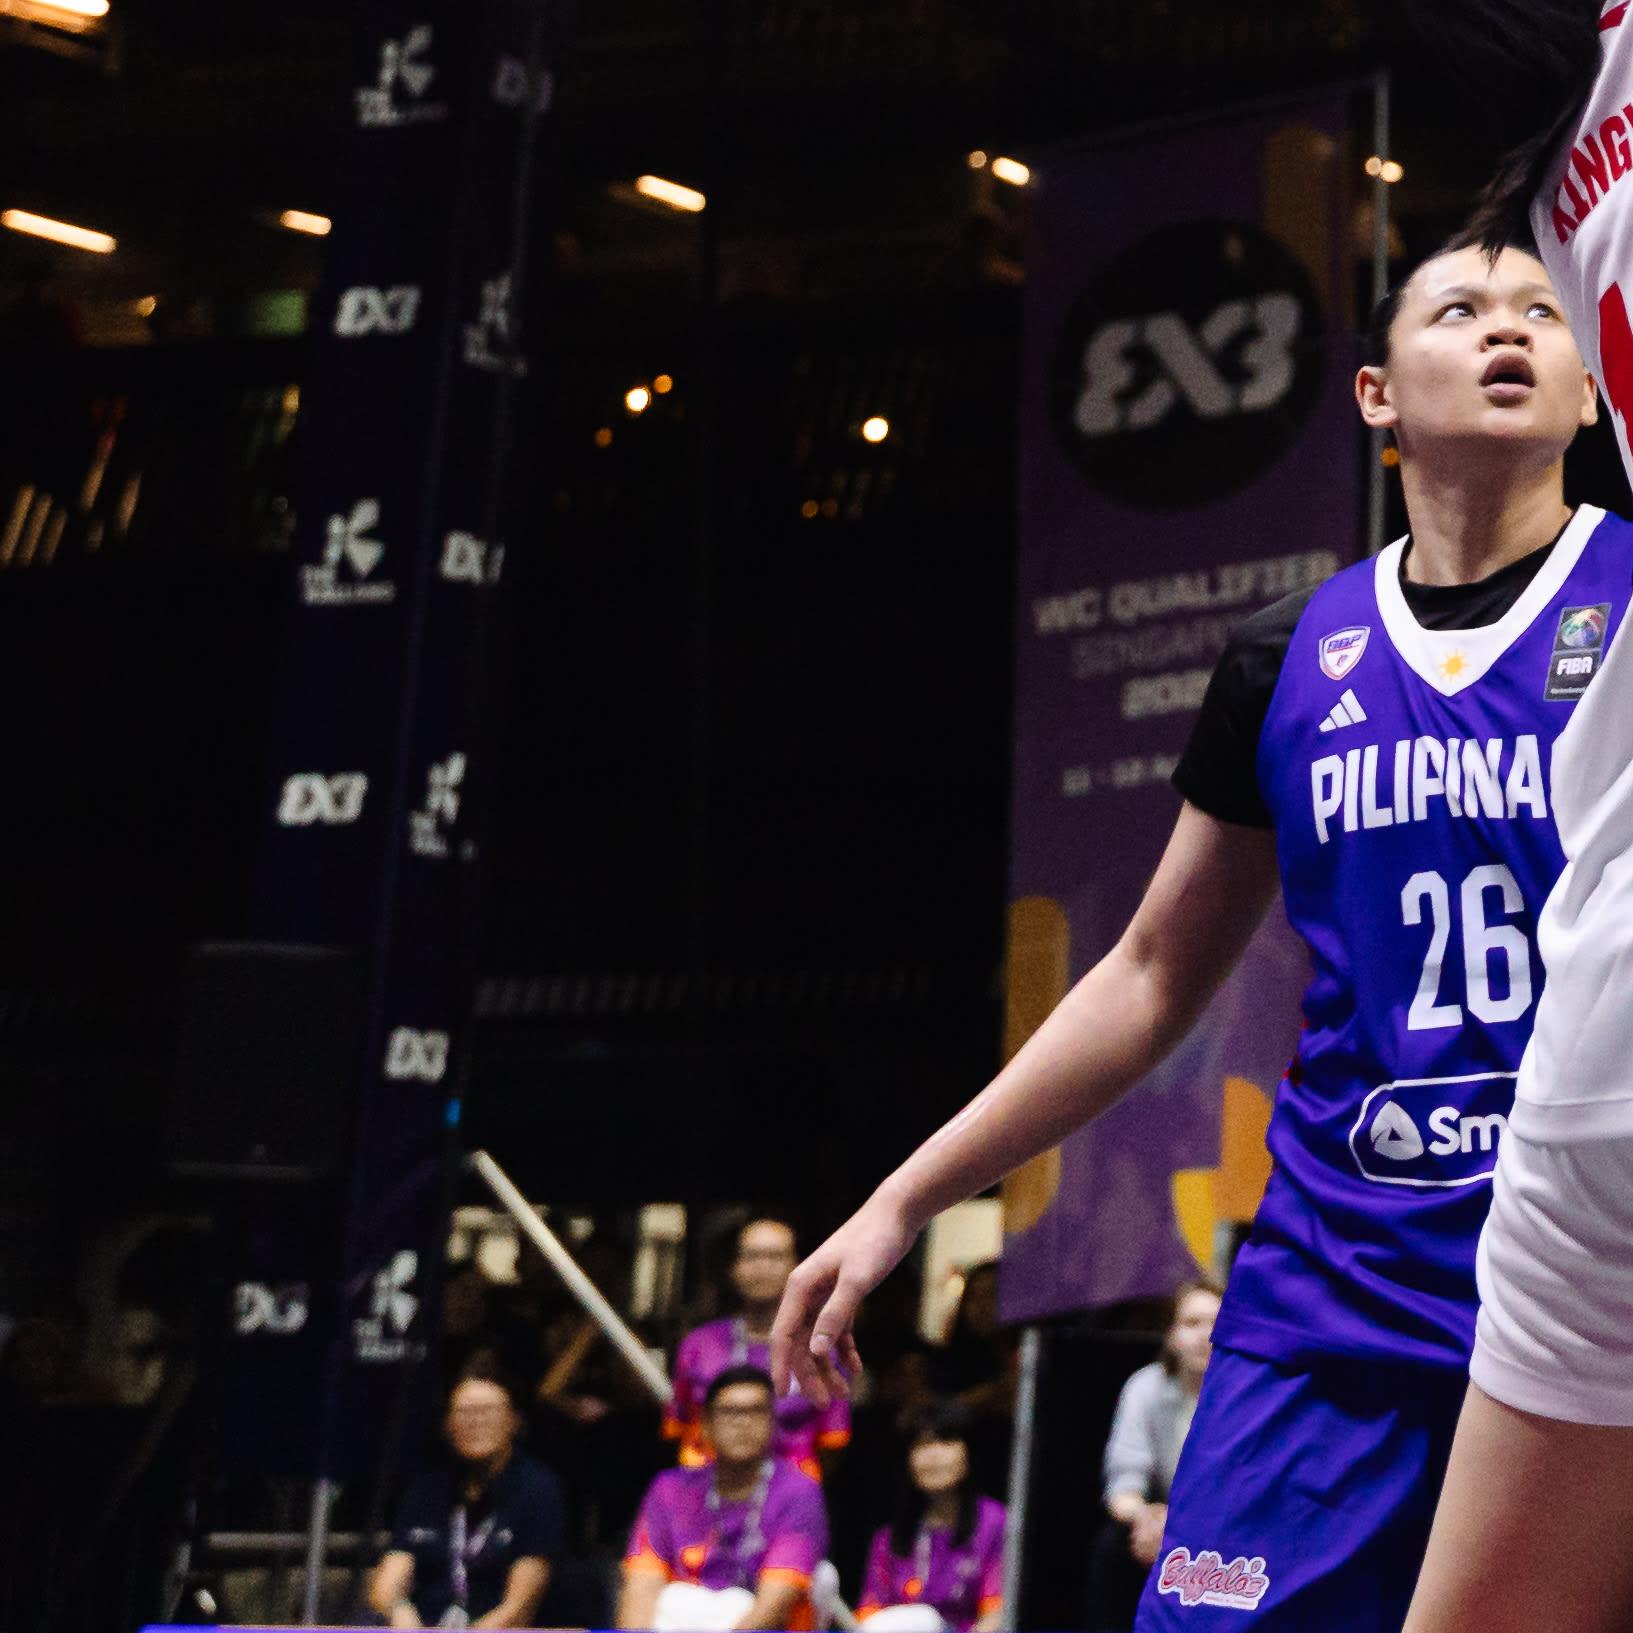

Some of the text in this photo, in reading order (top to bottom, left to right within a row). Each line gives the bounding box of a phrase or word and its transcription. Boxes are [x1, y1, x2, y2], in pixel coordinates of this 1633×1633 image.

[1557, 656, 1594, 676] FIBA
[1311, 734, 1548, 845] PILIPINA
[1401, 863, 1533, 1031] 26
